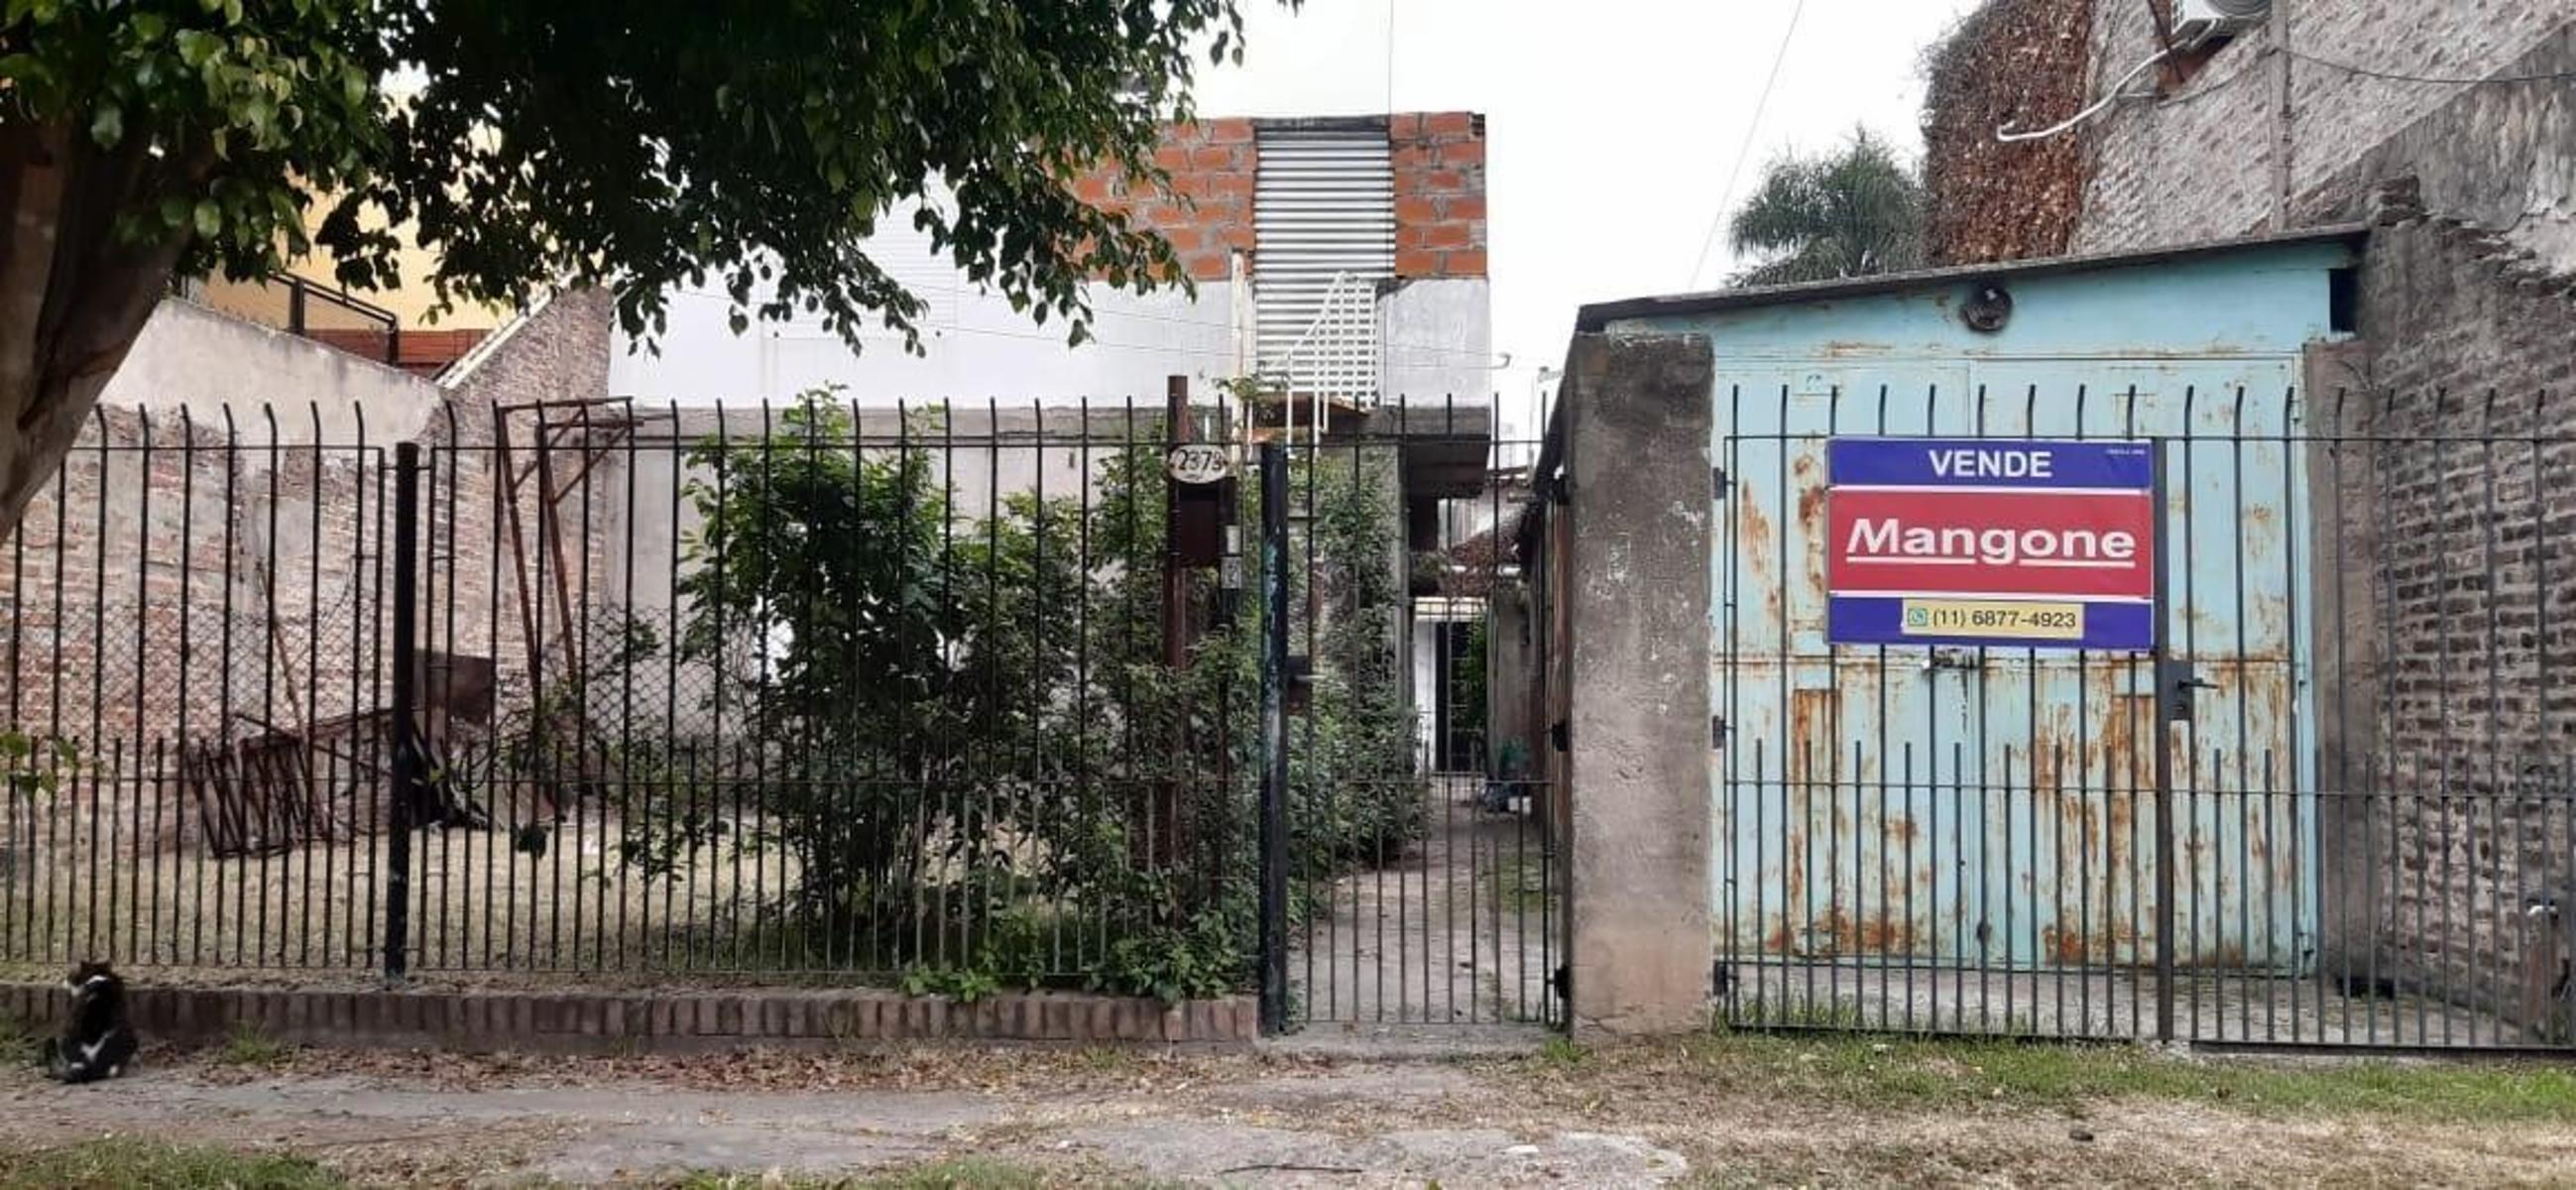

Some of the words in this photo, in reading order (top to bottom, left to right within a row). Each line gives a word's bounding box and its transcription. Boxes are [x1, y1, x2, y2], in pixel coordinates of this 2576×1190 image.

[1929, 450, 2052, 477] VENDE
[1846, 518, 2137, 566] Mangone
[1932, 609, 1967, 627] (11)
[1971, 611, 2077, 629] 6877-4923
